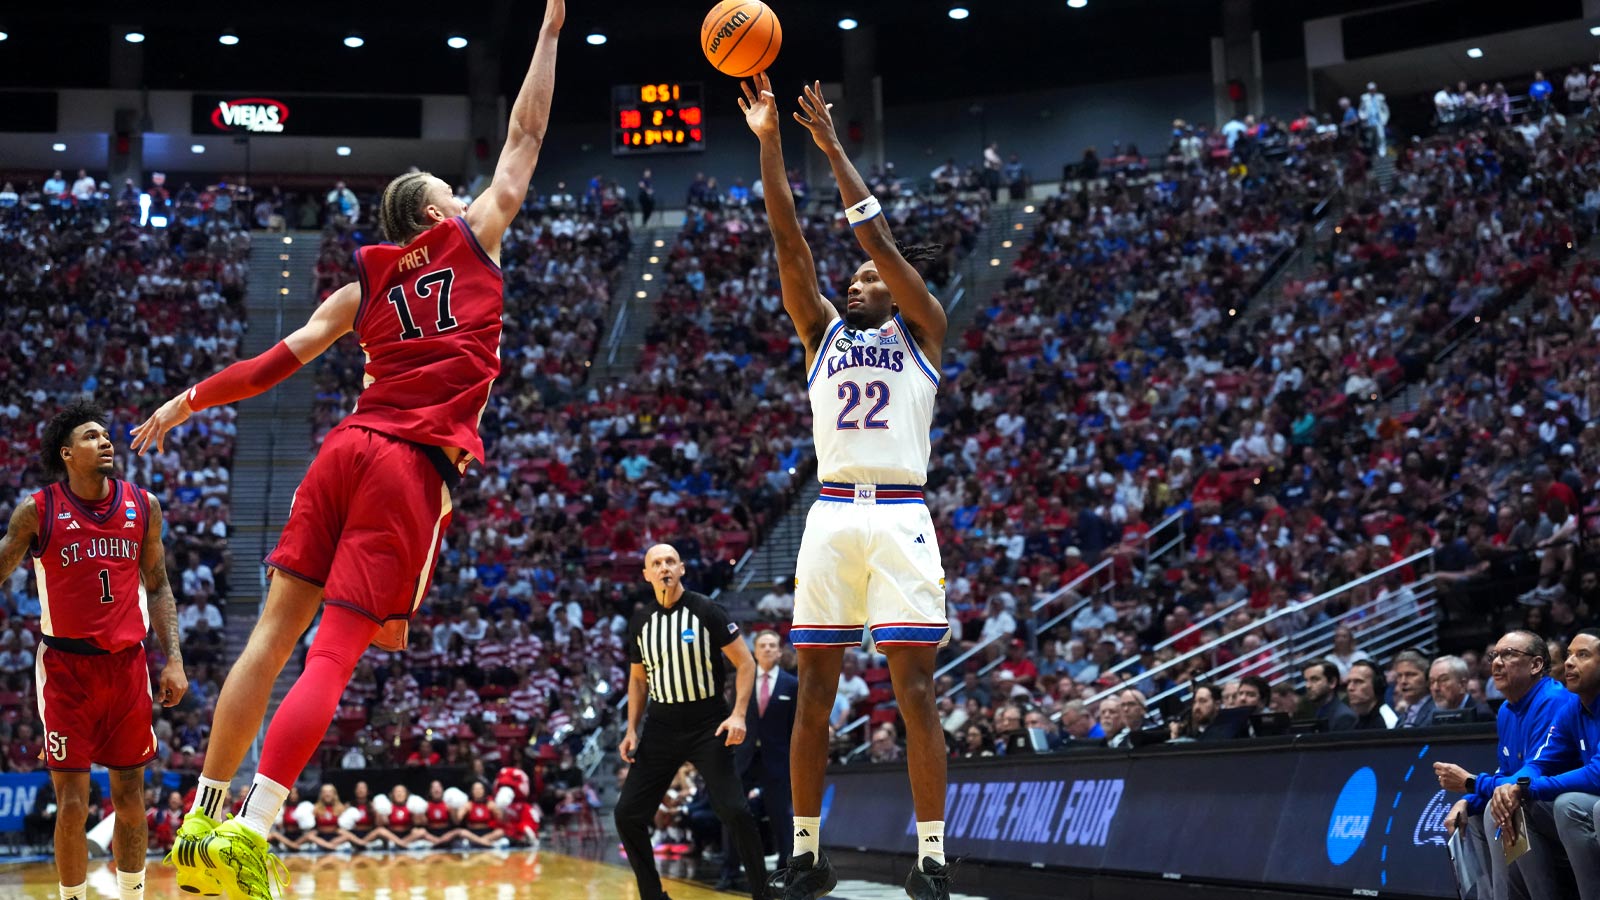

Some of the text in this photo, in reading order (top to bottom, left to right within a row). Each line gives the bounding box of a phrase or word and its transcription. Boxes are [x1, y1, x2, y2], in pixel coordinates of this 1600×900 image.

[709, 11, 751, 54] Wilson
[219, 101, 280, 126] VIEJAS
[398, 245, 431, 272] PREY
[387, 267, 458, 341] 17
[827, 345, 904, 379] KANSAS
[836, 380, 891, 431] 22
[858, 489, 872, 499] KU
[60, 538, 139, 567] ST. JOHN'S
[99, 568, 115, 604] 1
[947, 783, 981, 839] TO
[969, 782, 1017, 841] THE
[1000, 781, 1065, 844] FINAL
[1052, 779, 1125, 847] FOUR
[1330, 815, 1370, 839] NCAA
